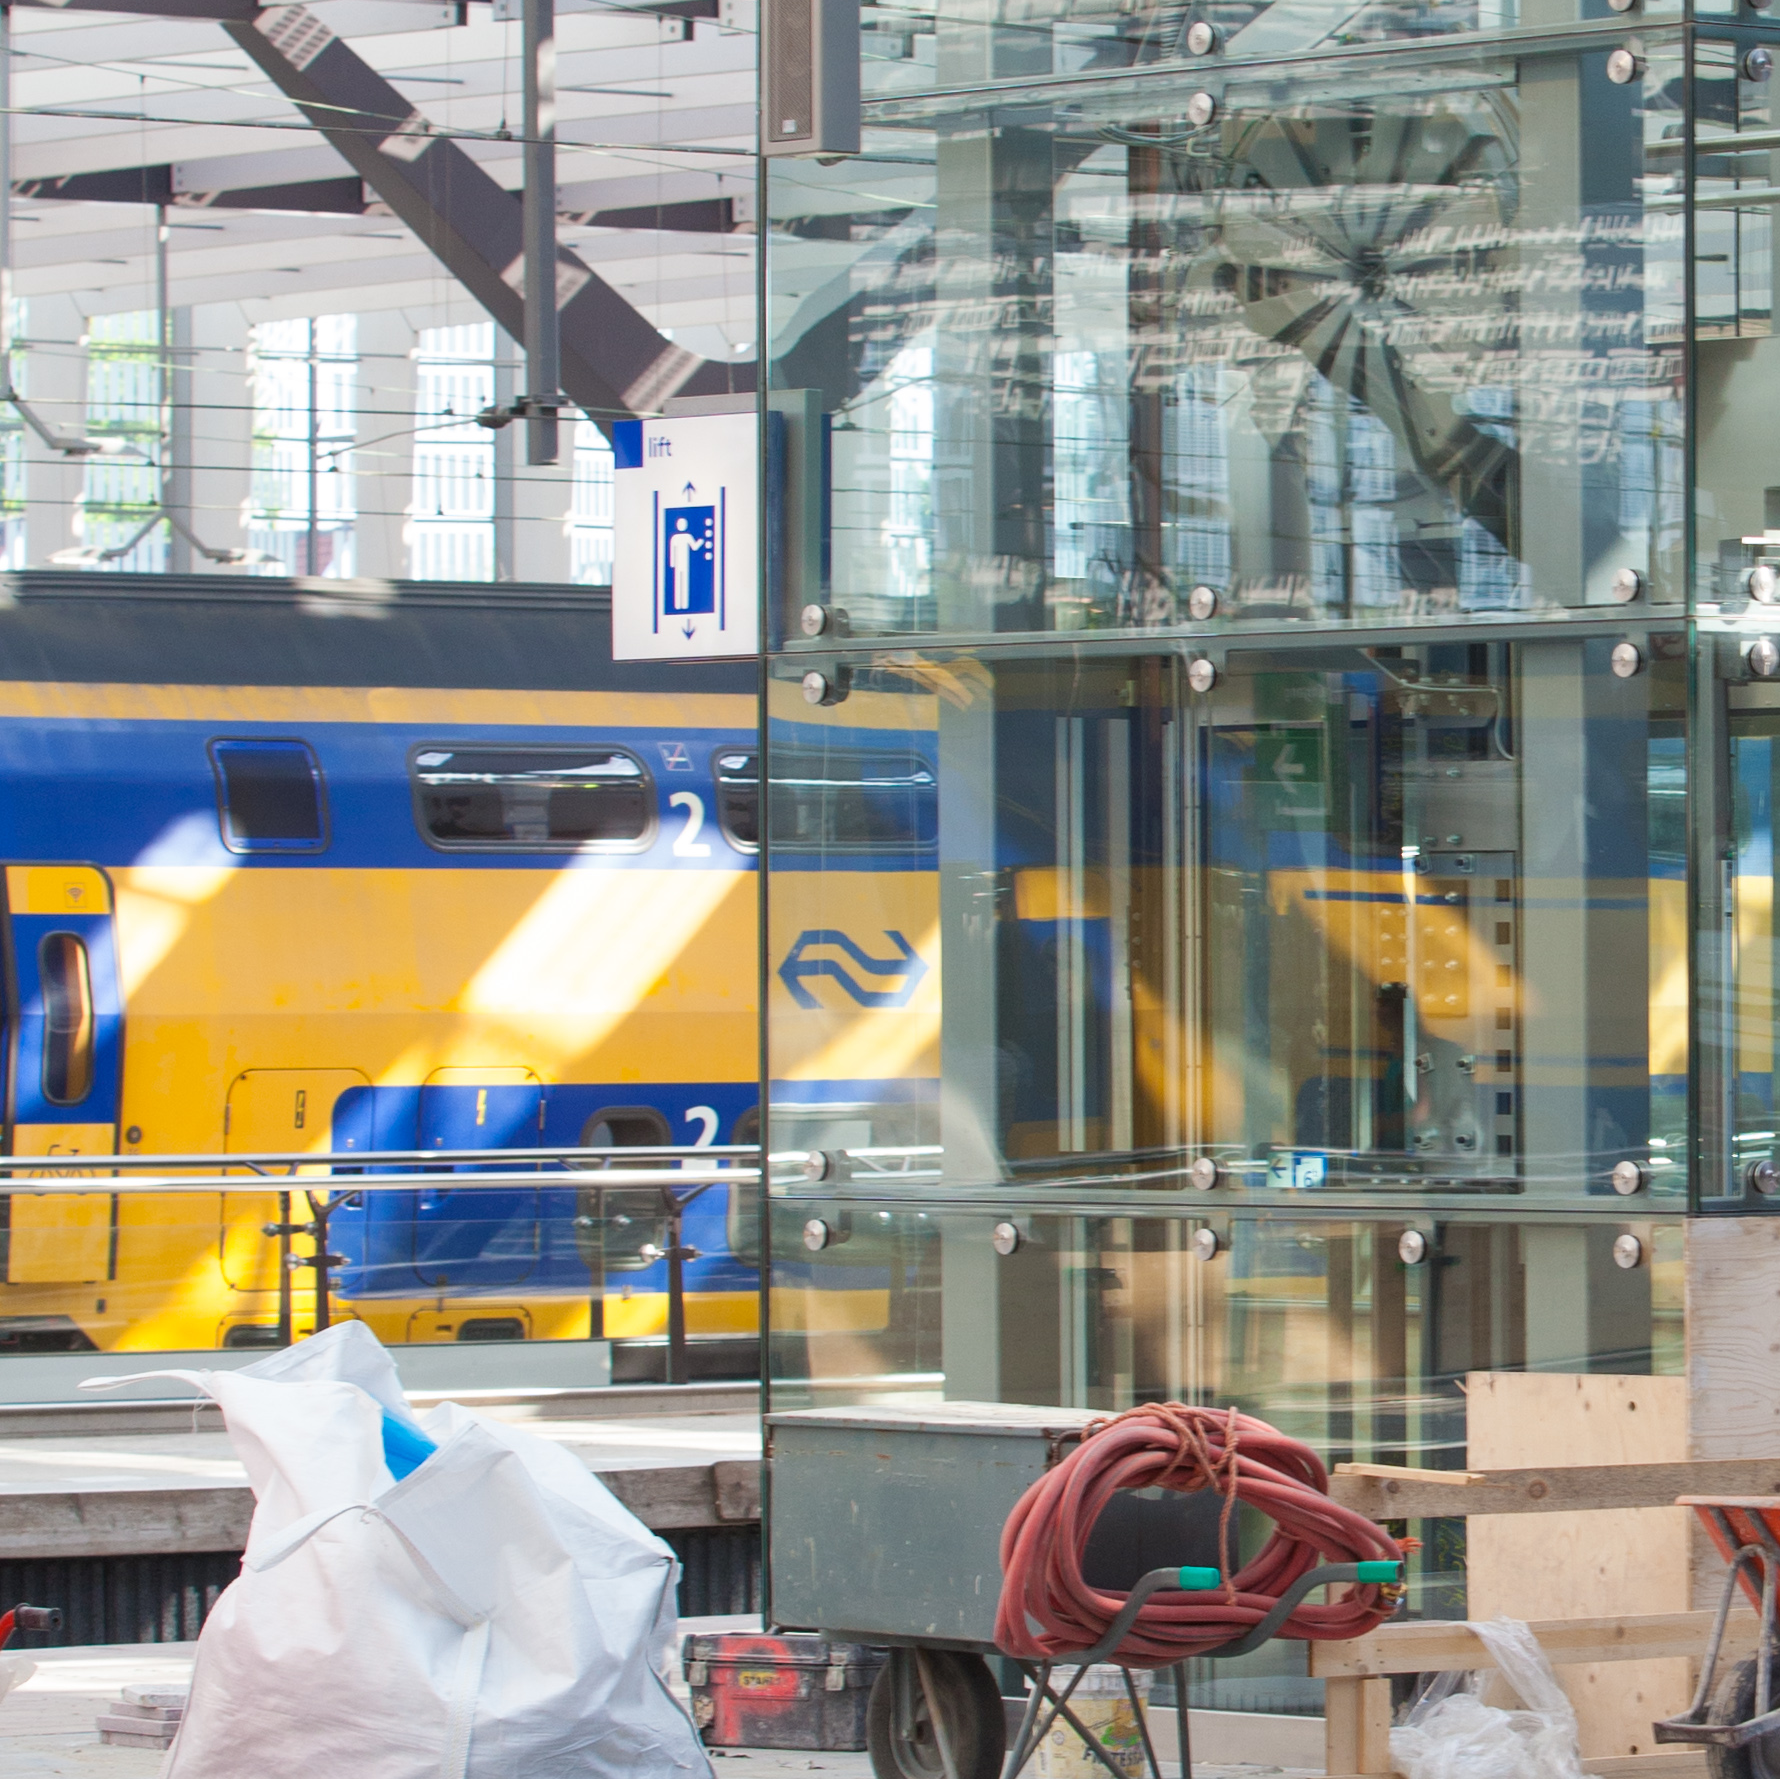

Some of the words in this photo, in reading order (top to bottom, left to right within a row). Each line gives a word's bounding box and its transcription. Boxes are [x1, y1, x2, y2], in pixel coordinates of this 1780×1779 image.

[648, 436, 672, 457] lift
[669, 791, 711, 857] 2
[681, 1105, 718, 1171] 2
